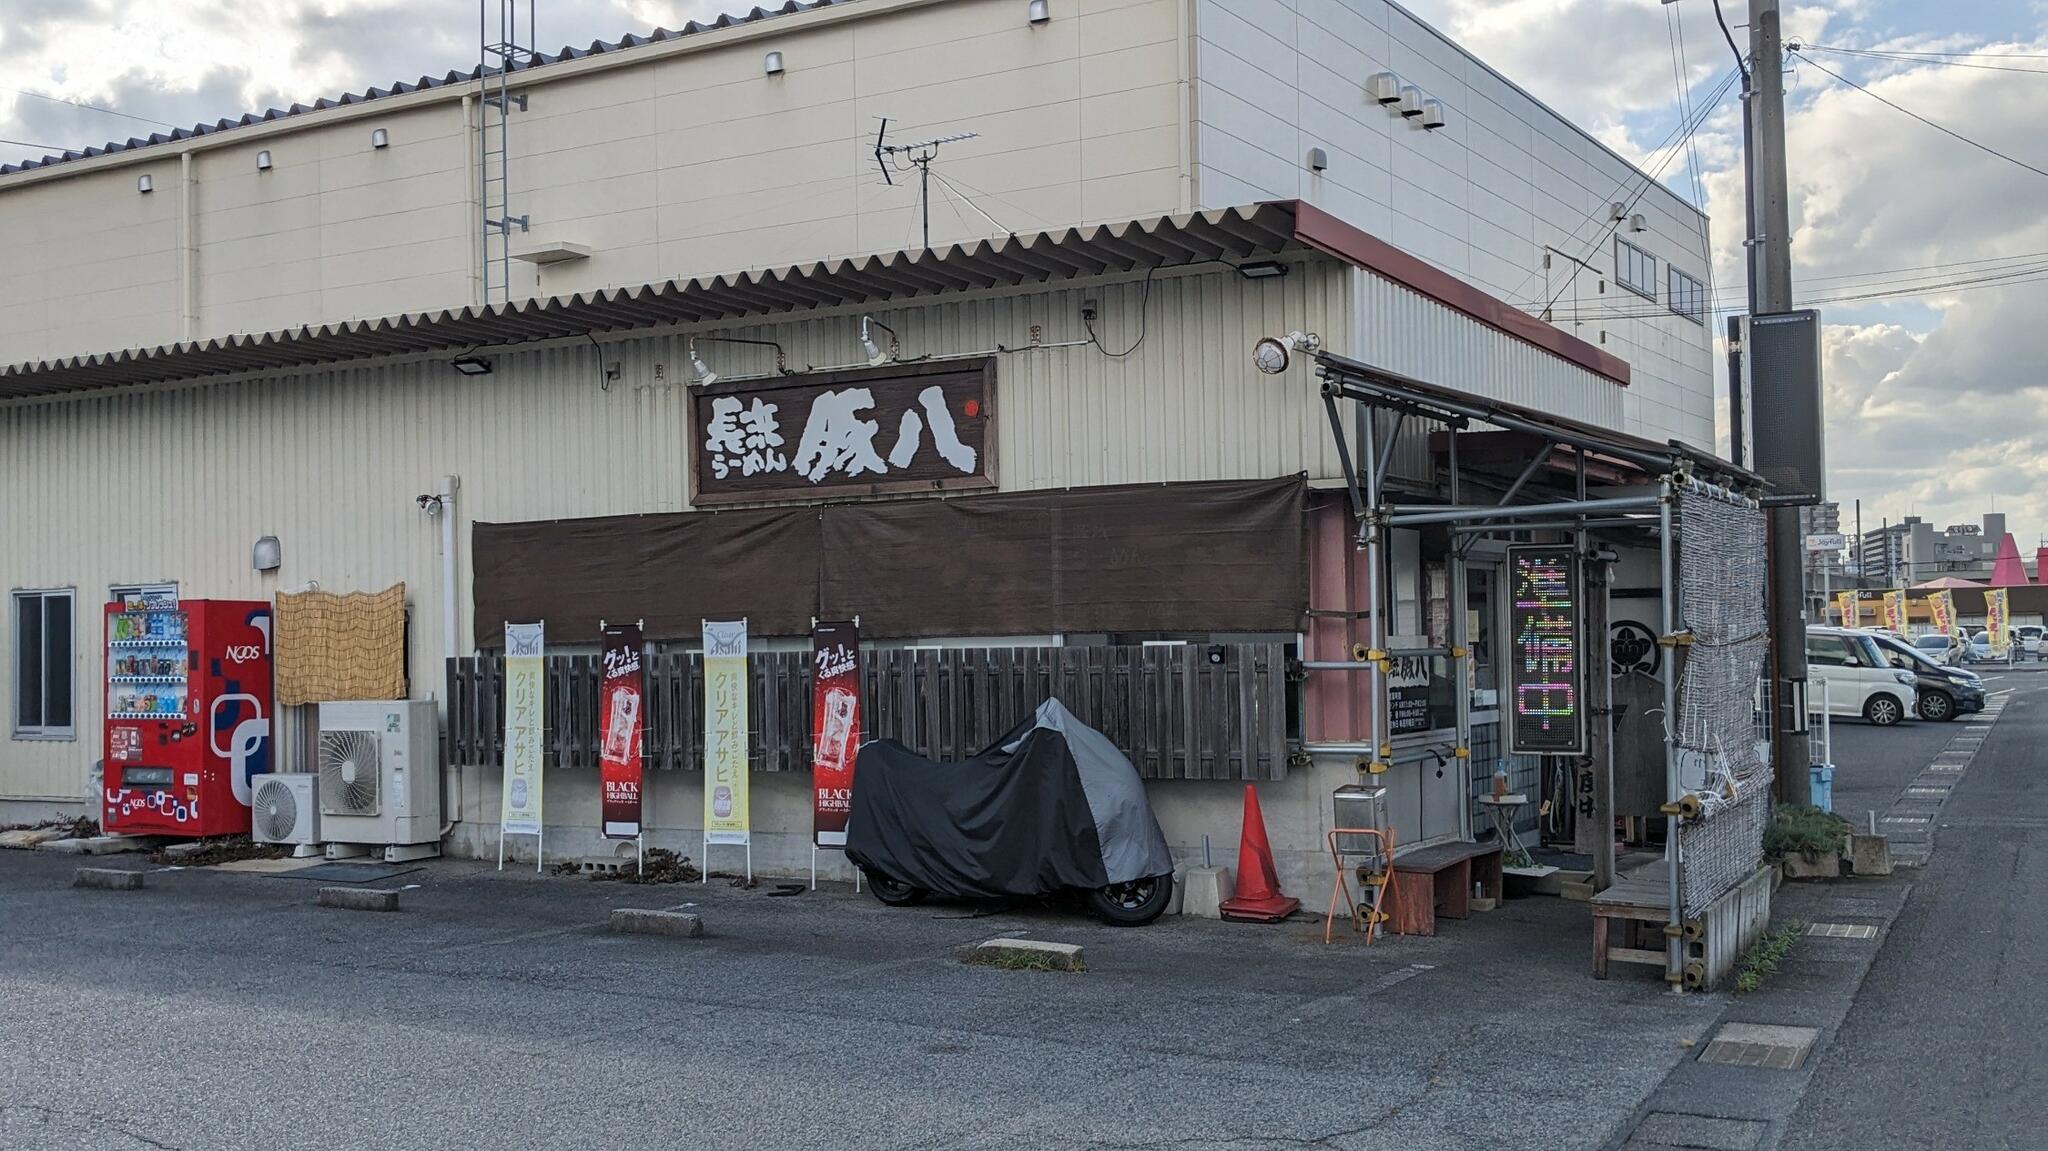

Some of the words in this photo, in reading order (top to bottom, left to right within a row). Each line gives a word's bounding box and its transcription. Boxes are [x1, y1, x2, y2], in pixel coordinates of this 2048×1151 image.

[711, 448, 787, 480] らーめん
[1817, 537, 1842, 546] Joyfull
[511, 641, 539, 656] Asahi
[710, 639, 741, 656] Asahi
[1516, 559, 1574, 730] 準備中
[606, 781, 639, 793] BLACK
[606, 792, 638, 800] HIGHBALL
